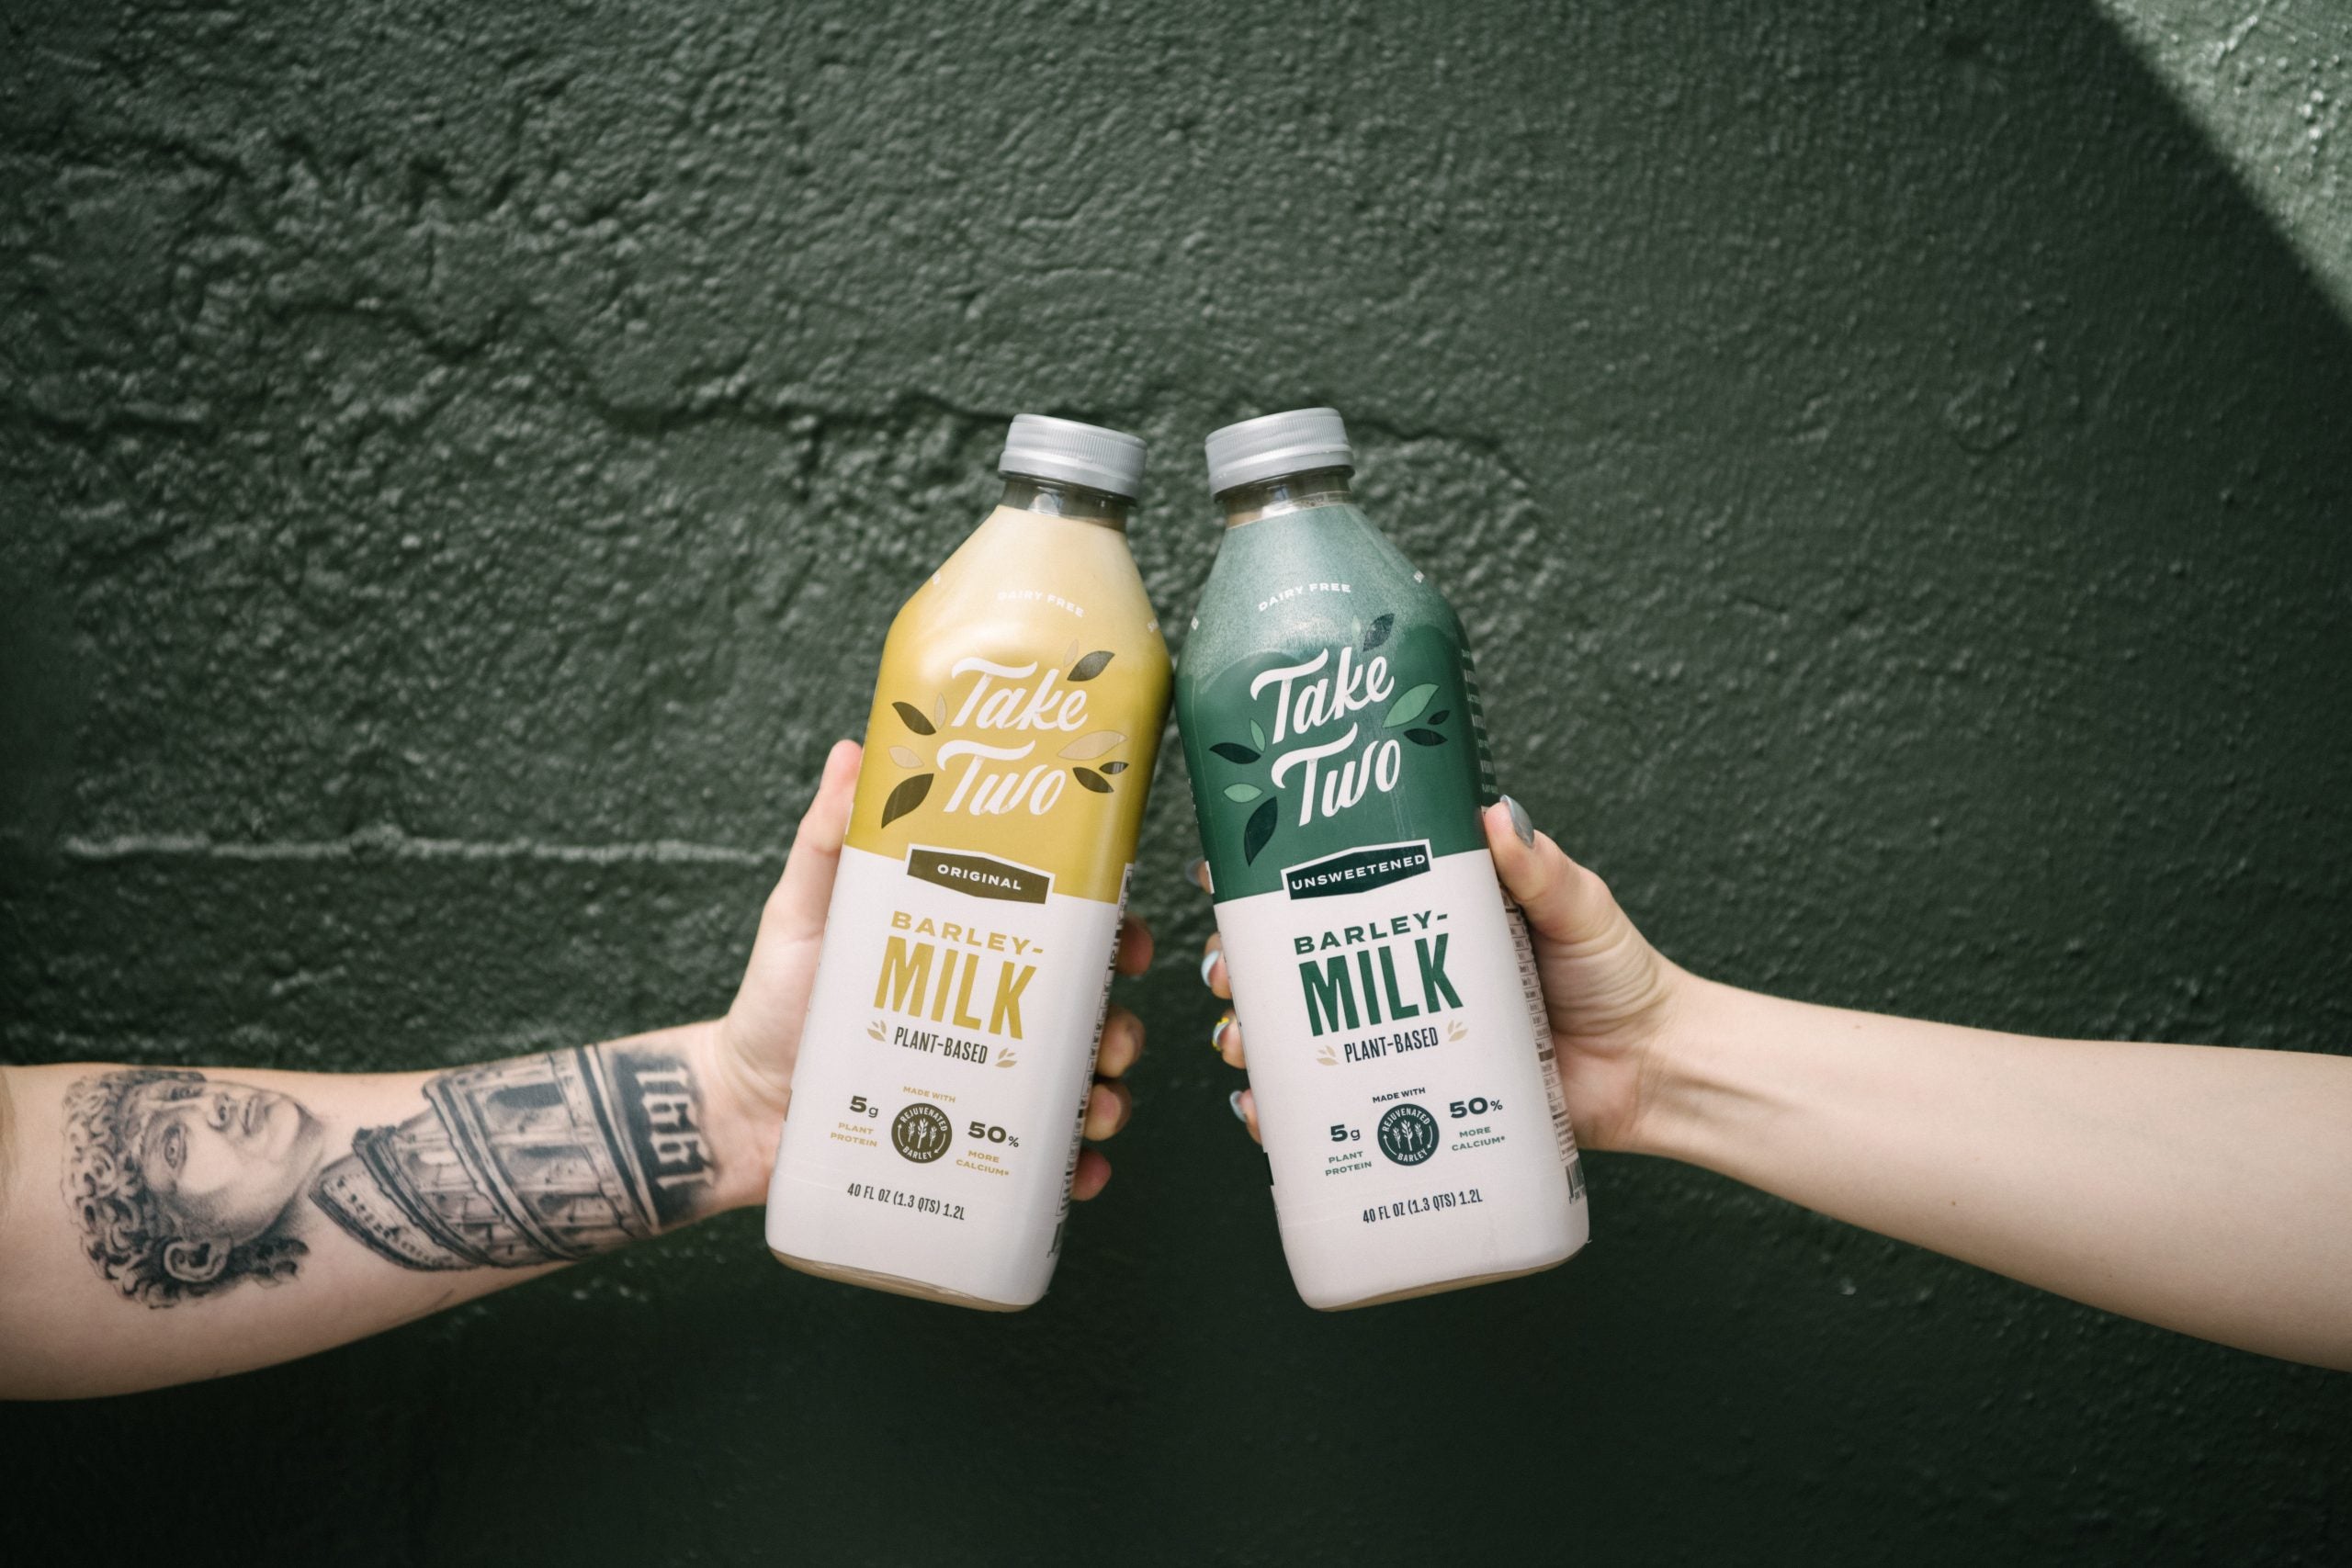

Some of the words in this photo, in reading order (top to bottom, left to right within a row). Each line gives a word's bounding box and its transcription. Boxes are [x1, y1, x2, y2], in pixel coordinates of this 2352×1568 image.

[997, 589, 1043, 602] DAIRY
[1047, 593, 1084, 618] FREE
[1259, 585, 1303, 612] DAIRY
[1309, 582, 1351, 593] FREE
[952, 657, 1089, 731] Take
[1250, 647, 1395, 744] Take
[936, 739, 1067, 816] Two
[1271, 722, 1401, 827] Two
[937, 863, 1023, 891] ORIGINAL
[1292, 854, 1426, 891] UNSWEETENED
[891, 910, 1044, 955] BARLEY-
[1294, 910, 1448, 955] BARLEY-
[874, 935, 1037, 1040] MILK
[1299, 932, 1464, 1037] MILK
[894, 1026, 989, 1065] PLANT-BASED
[1344, 1026, 1439, 1063] PLANT-BASED
[903, 1086, 931, 1098] MADE
[932, 1091, 956, 1103] WITH
[1373, 1092, 1399, 1103] MADE
[1401, 1087, 1426, 1098] WITH
[1450, 1097, 1503, 1119] 50%
[838, 1122, 875, 1135] PLANT
[899, 1107, 948, 1133] REJUVENATED
[1382, 1107, 1430, 1133] REJUVENATED
[1459, 1126, 1491, 1138] MORE
[831, 1131, 877, 1147] PROTEIN
[967, 1121, 1020, 1148] 50%
[902, 1145, 933, 1160] BARLEY
[967, 1150, 1000, 1164] MORE
[1329, 1150, 1363, 1164] PLANT
[1397, 1149, 1428, 1163] BARLEY
[1325, 1161, 1372, 1177] PROTEIN
[847, 1182, 862, 1197] 40
[864, 1186, 875, 1201] FL
[877, 1189, 892, 1203] OZ
[893, 1190, 914, 1208] (1.3
[918, 1196, 941, 1214] QTS)
[943, 1202, 965, 1221] 1.2L
[1363, 1208, 1376, 1224] 40
[1379, 1205, 1390, 1221] FL
[1393, 1202, 1406, 1217] OZ
[1408, 1198, 1430, 1214] (1.3
[1433, 1191, 1456, 1211] QTS)
[1459, 1188, 1483, 1206] 1.2L
